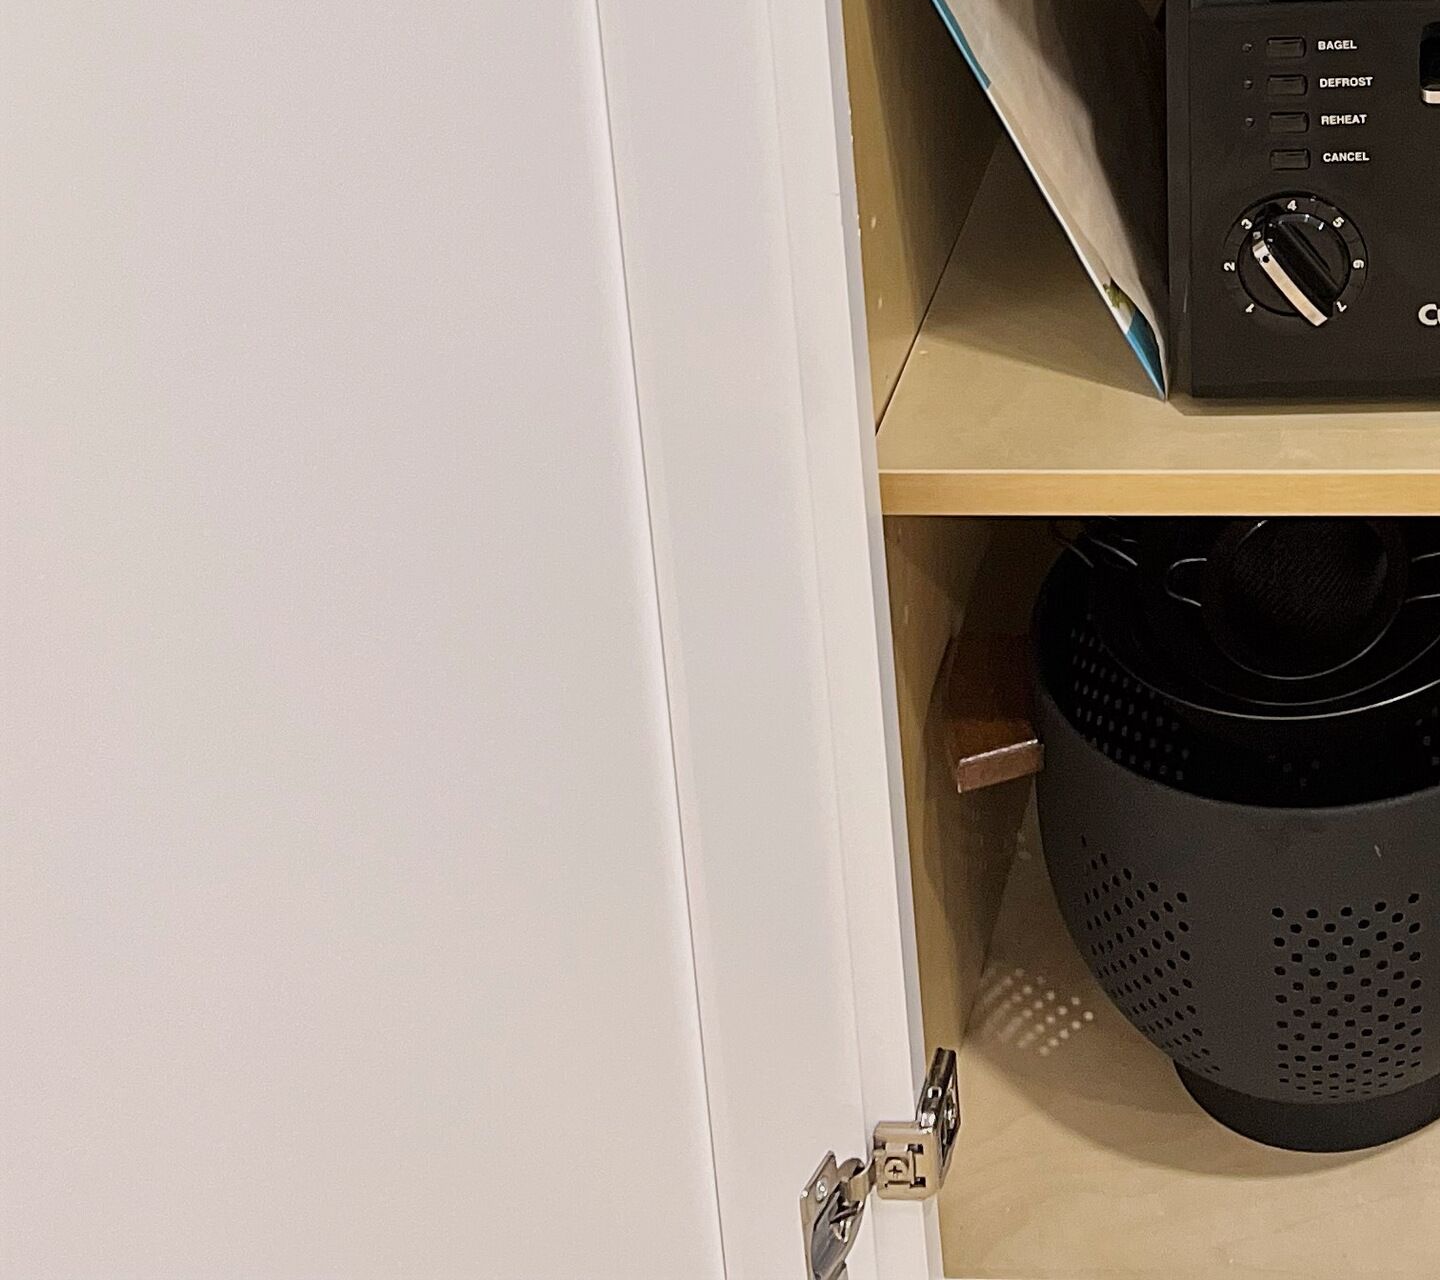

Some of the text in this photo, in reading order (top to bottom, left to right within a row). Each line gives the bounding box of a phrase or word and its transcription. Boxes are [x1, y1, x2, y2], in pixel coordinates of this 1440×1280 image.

[1317, 40, 1358, 51] BAGEL
[1319, 76, 1374, 88] DEFROST
[1321, 114, 1368, 125] REHEAT
[1322, 152, 1370, 162] CANCEL
[1287, 200, 1298, 211] 4
[1241, 219, 1253, 230] 3
[1332, 216, 1345, 228] 5
[1223, 262, 1236, 272] 2
[1245, 303, 1255, 314] 1
